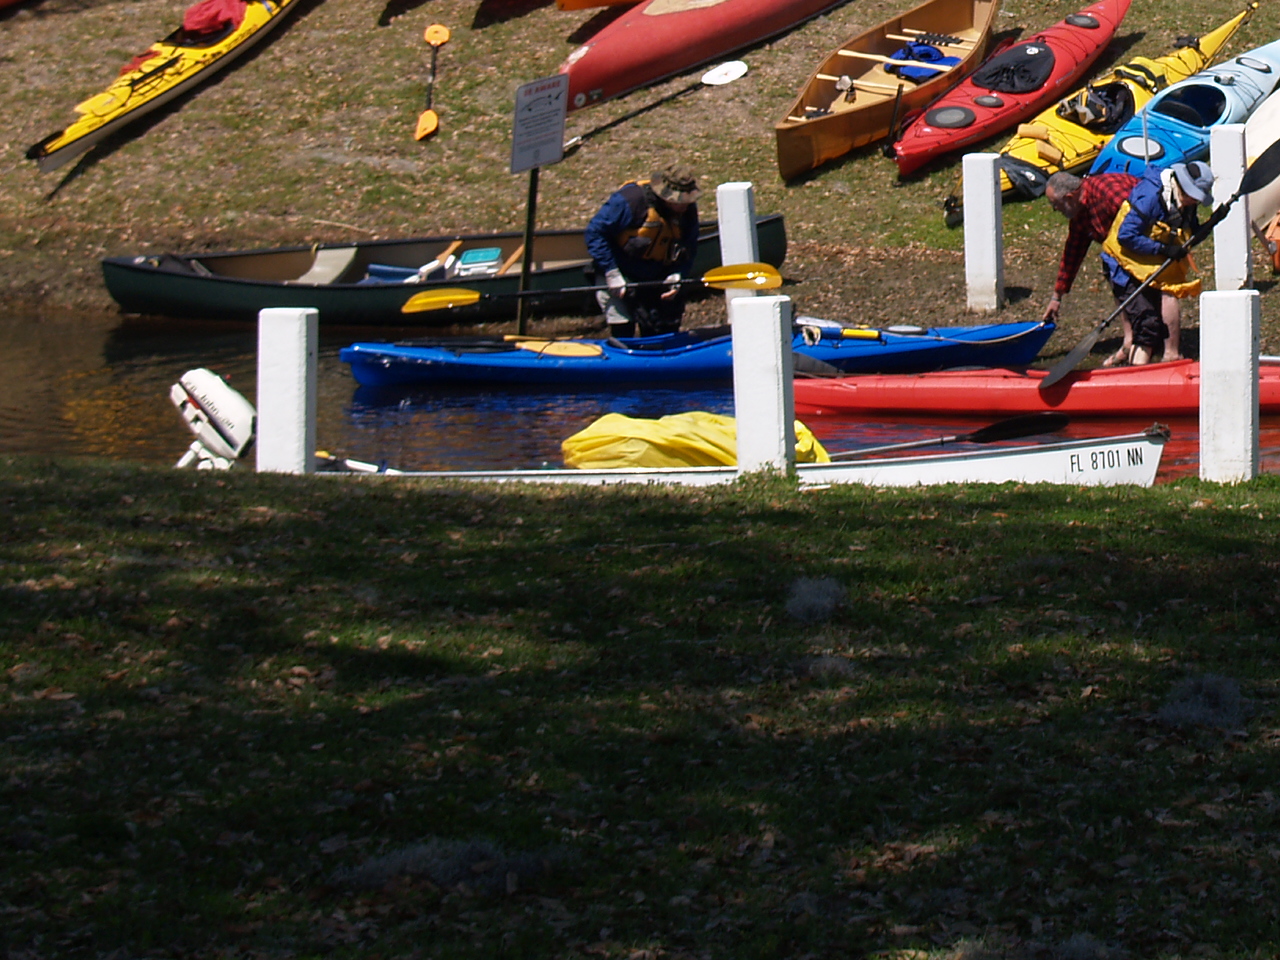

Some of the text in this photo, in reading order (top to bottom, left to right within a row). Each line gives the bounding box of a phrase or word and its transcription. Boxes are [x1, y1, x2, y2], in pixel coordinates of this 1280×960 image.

[1070, 447, 1143, 473] FL 8701 NN
